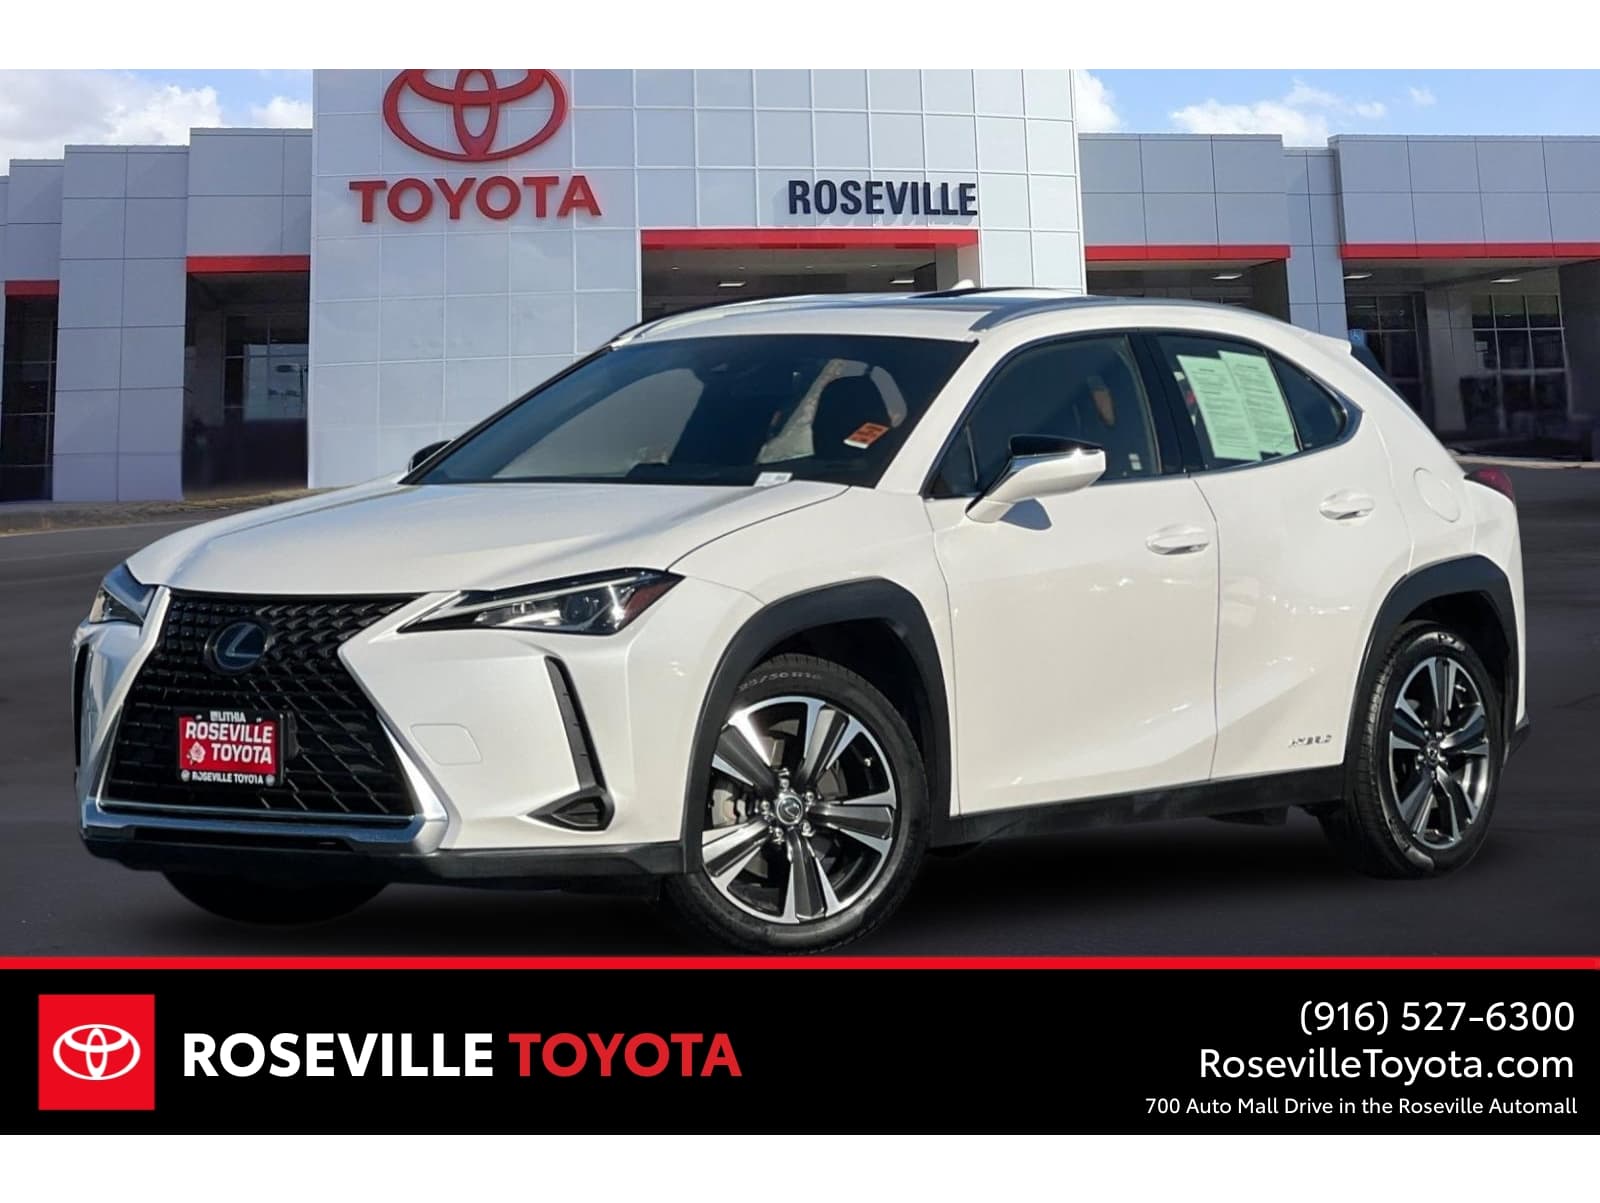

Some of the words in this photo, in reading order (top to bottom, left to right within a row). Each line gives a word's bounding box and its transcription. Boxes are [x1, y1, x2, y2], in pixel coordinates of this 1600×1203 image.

[349, 175, 602, 223] TOYOTA
[788, 179, 978, 216] ROSEVILLE
[185, 721, 273, 744] ROSEVILLE
[211, 743, 272, 765] TOYOTA
[192, 771, 233, 783] ROSEVILLE
[234, 773, 264, 785] TOYOTA
